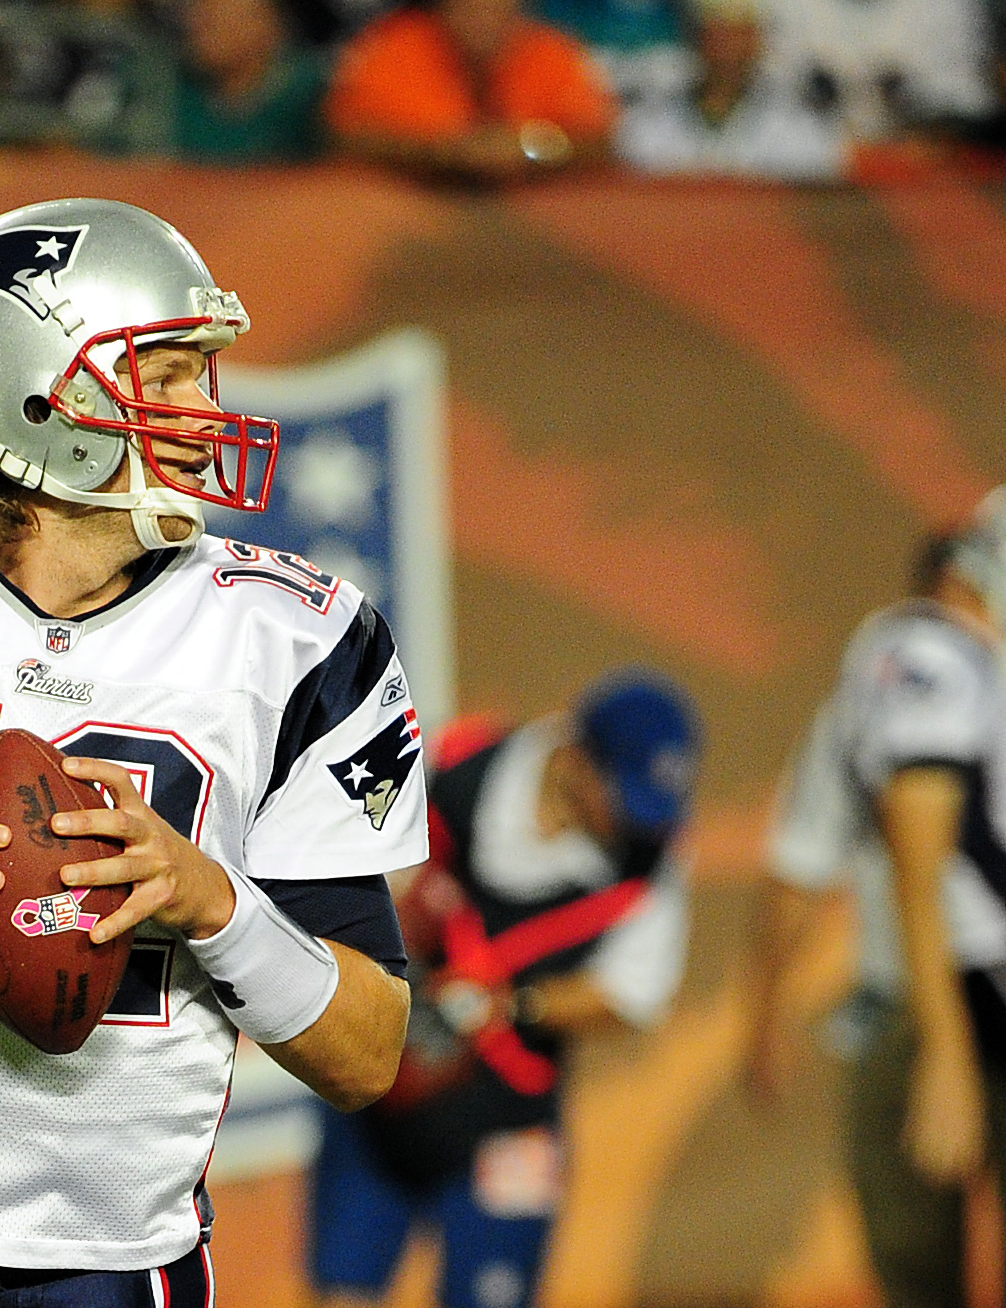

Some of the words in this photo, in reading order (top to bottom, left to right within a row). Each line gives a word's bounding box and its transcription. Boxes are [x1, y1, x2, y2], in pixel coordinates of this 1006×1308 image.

[48, 636, 70, 651] NFL
[15, 667, 94, 702] Patriots
[55, 897, 75, 926] NFL
